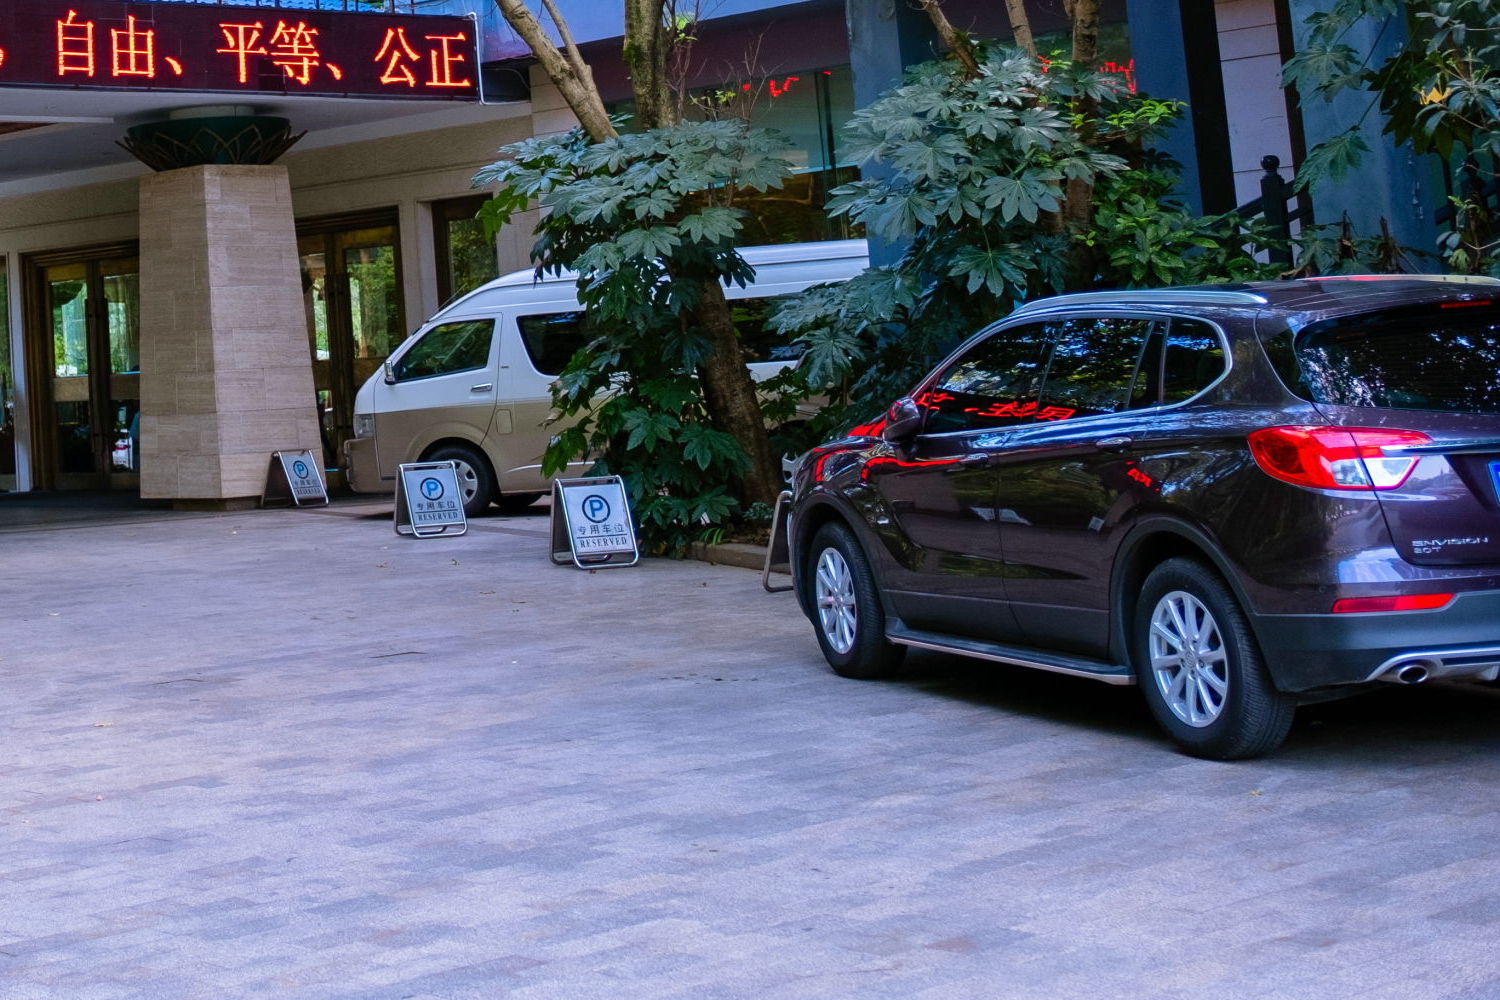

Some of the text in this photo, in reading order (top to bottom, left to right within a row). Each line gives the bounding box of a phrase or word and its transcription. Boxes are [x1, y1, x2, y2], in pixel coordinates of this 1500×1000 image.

[417, 512, 458, 521] RESERVED
[578, 524, 624, 535] 专用车位
[580, 537, 627, 548] RESERVED
